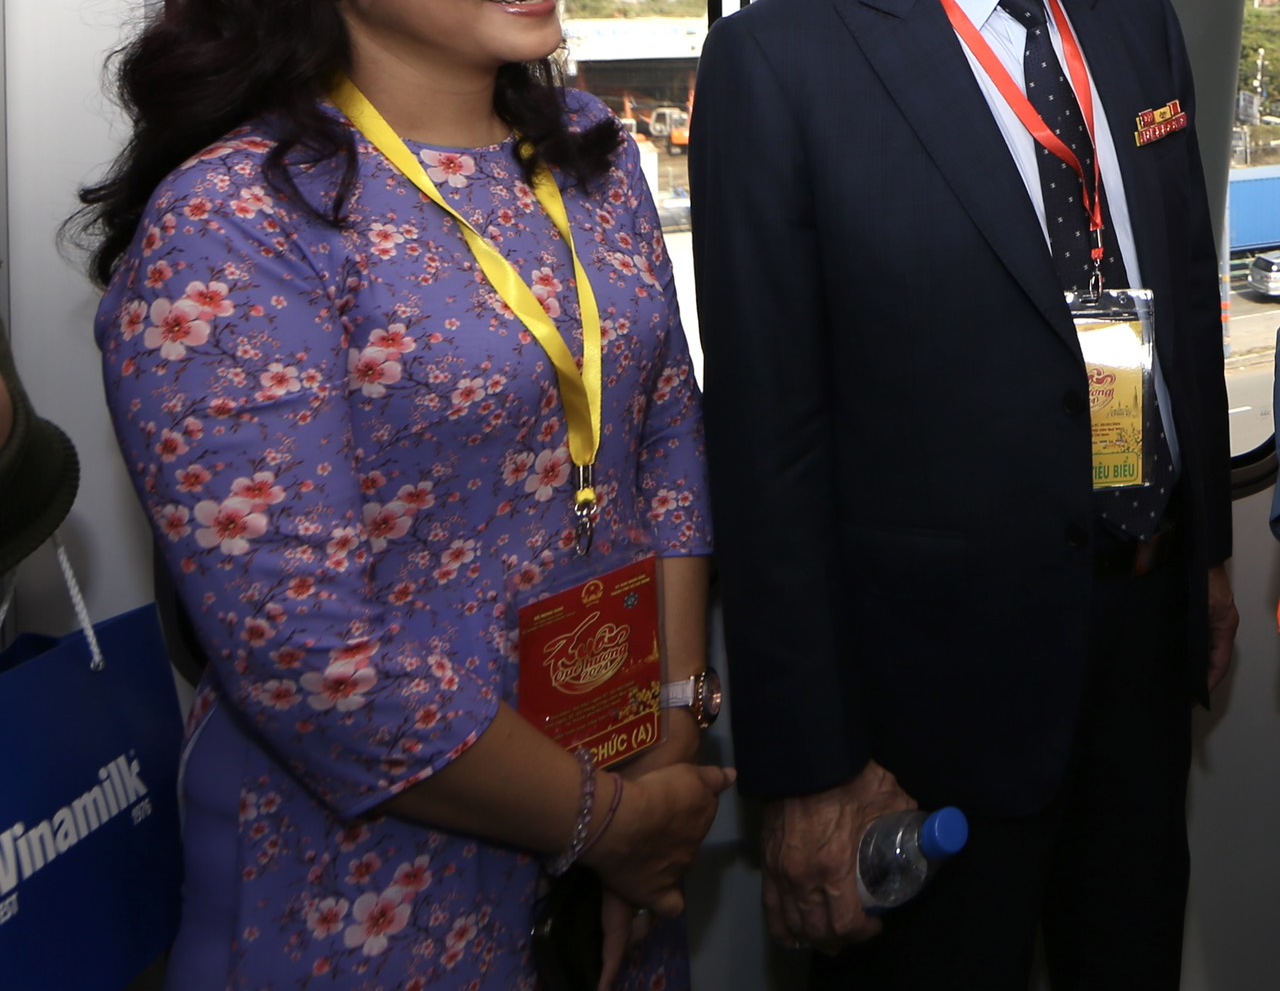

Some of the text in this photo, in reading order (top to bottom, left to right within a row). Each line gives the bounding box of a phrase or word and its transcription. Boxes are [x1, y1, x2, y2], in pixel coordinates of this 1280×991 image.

[1093, 460, 1110, 480] IÊU
[590, 722, 653, 764] CHỨC (A)
[0, 754, 149, 897] Vinamilk
